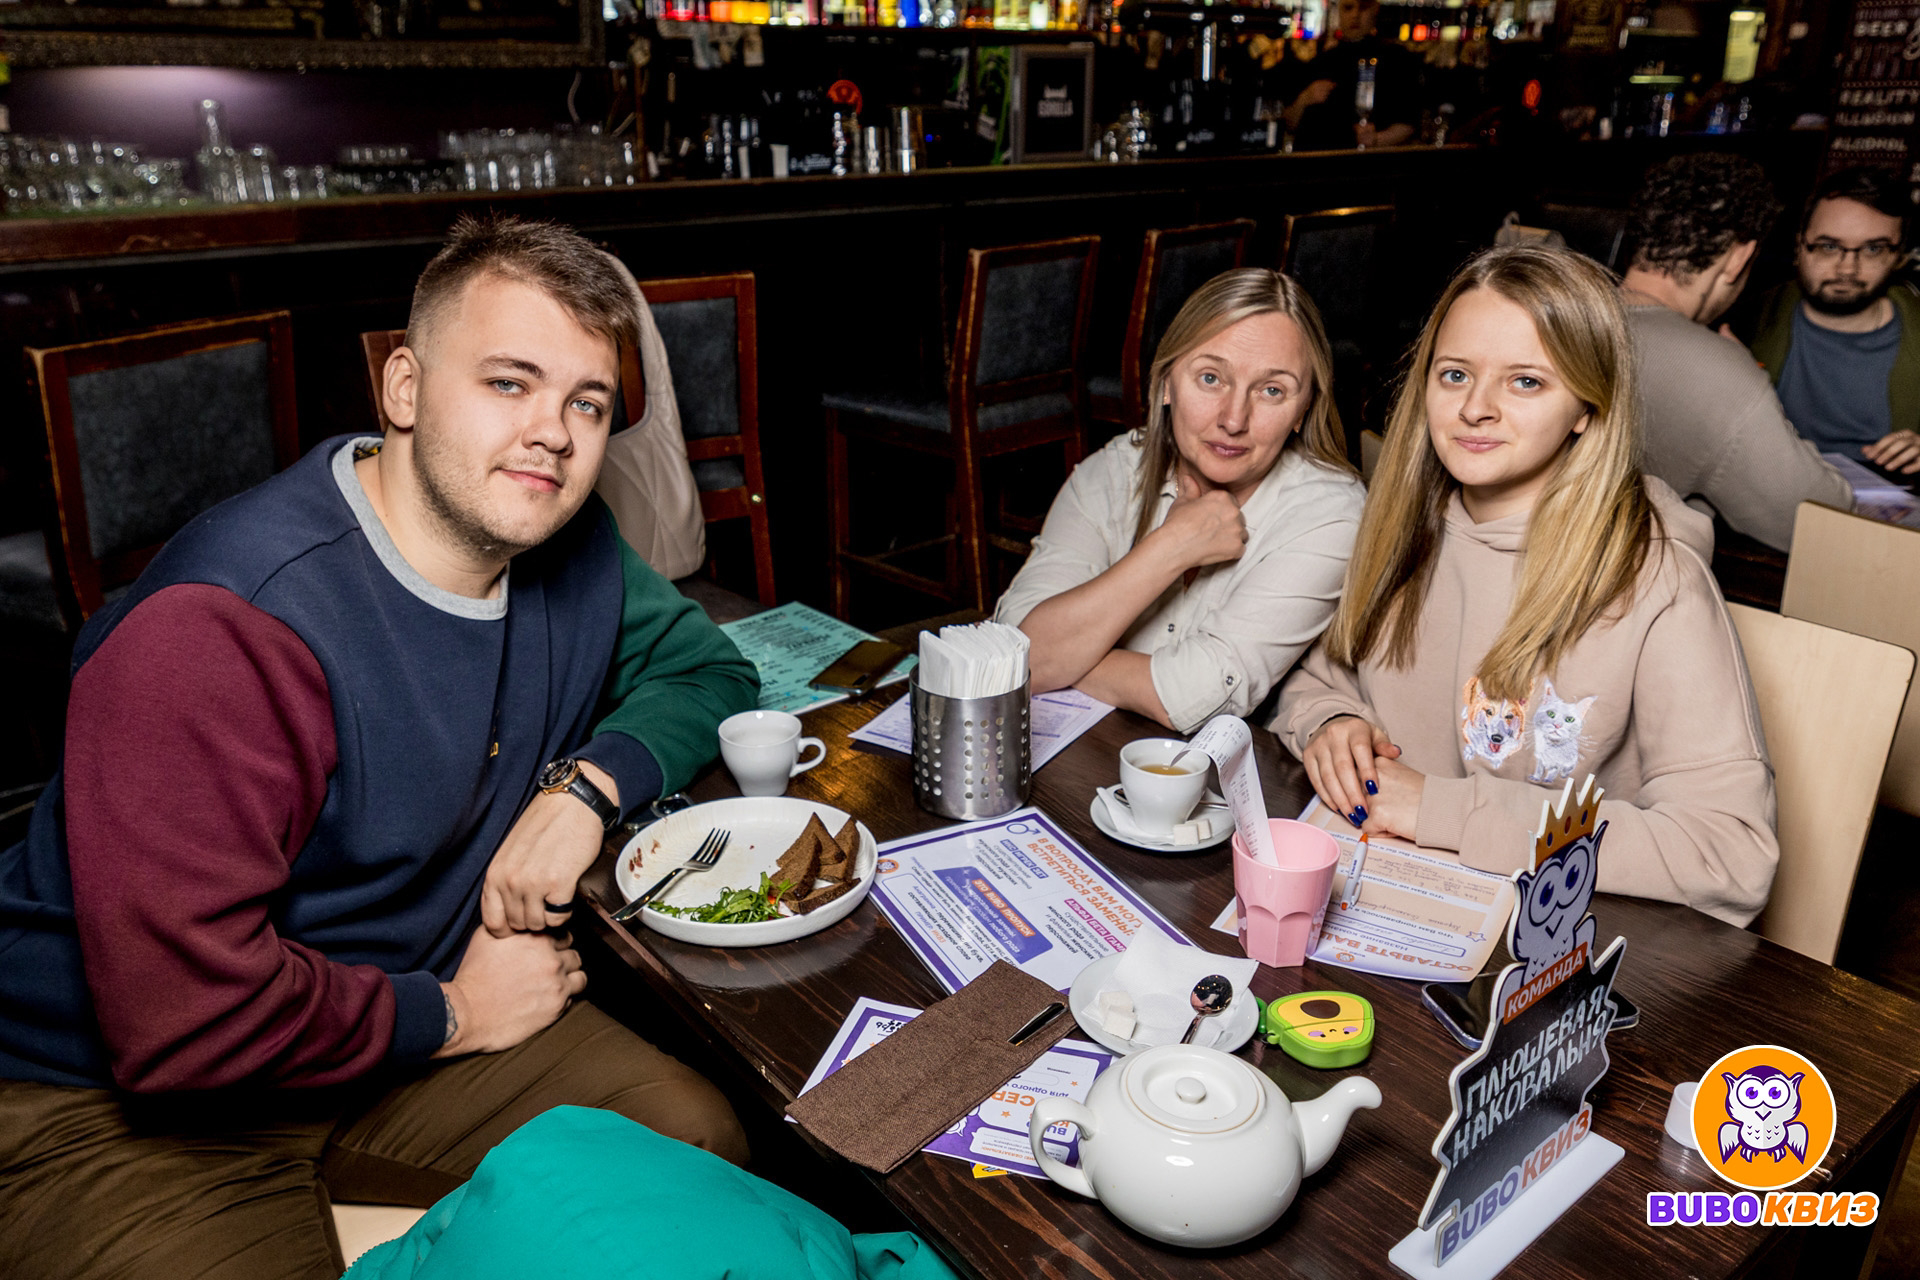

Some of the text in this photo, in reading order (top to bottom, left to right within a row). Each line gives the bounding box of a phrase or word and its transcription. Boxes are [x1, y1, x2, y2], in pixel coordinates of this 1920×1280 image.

[995, 866, 1017, 885] мужских
[996, 858, 1010, 868] рода
[1031, 868, 1046, 877] ЗЕТ
[1043, 843, 1097, 885] ВОПРОСАХ
[1090, 885, 1119, 904] ВАМ
[1026, 842, 1136, 936] ВСТРЕТИТЬСЯ ЗАМЕНЫ:
[973, 880, 989, 891] ЭТО
[1001, 908, 1034, 935] ПРОПУСК
[1047, 905, 1072, 927] женского
[1068, 927, 1085, 939] рода
[1066, 899, 1091, 919] АЛЬФА
[1088, 920, 1108, 934] БЕТА
[907, 892, 971, 960] составляющих исходное слово
[988, 922, 1009, 939] любого
[1003, 939, 1021, 953] рода
[1044, 924, 1079, 953] персонажей
[1359, 934, 1408, 951] Название
[1070, 938, 1095, 959] женских
[1364, 944, 1473, 972] ОСТАВЬТЕ
[1507, 952, 1584, 1014] КОМАНДА
[1466, 984, 1606, 1119] ПЛЮШЕВАЯ
[1452, 1010, 1608, 1168] НАКОВАЛЬНЯ
[1441, 1109, 1590, 1260] BUBO КВИЗ
